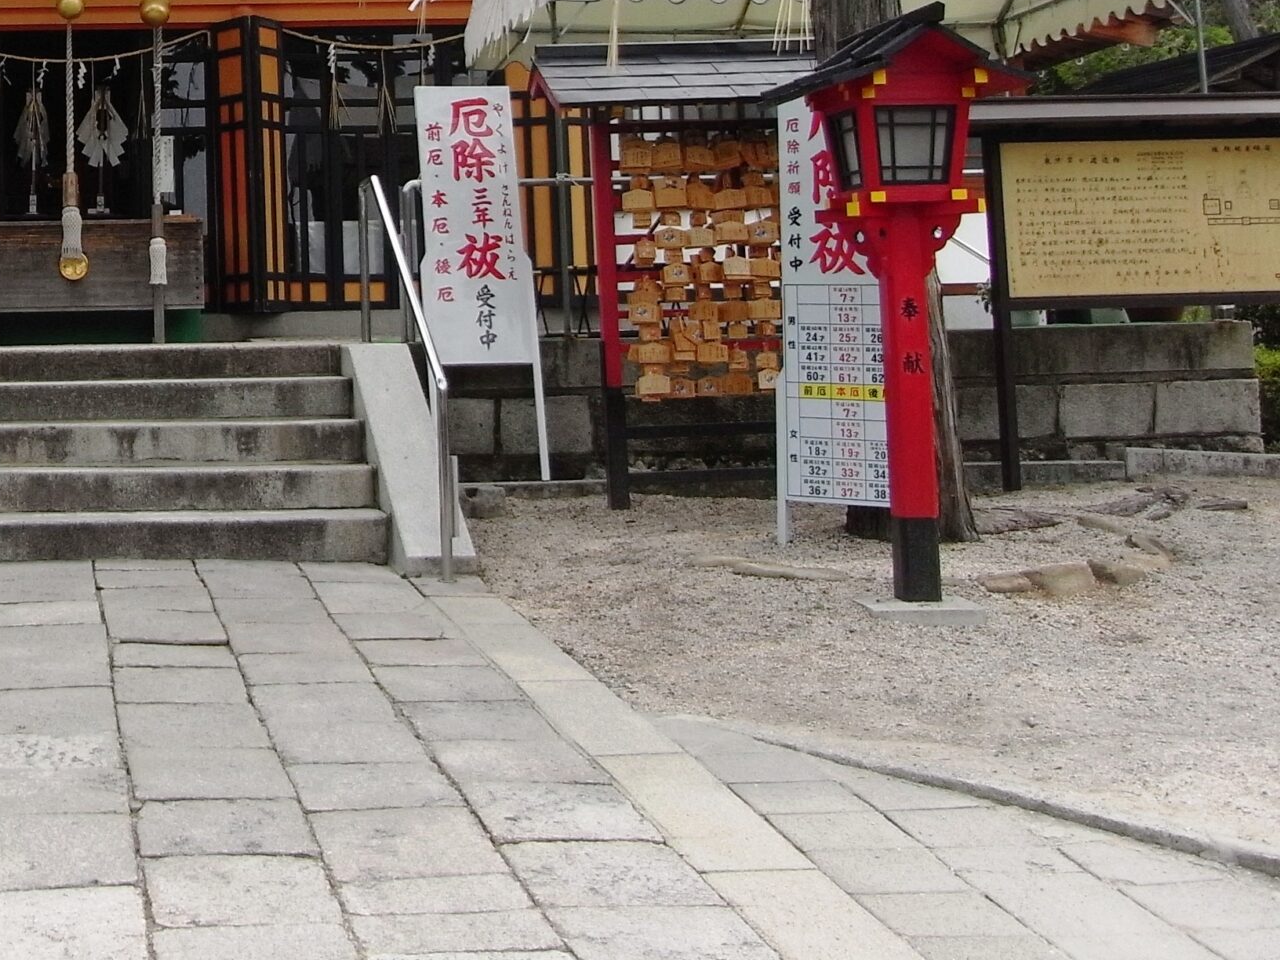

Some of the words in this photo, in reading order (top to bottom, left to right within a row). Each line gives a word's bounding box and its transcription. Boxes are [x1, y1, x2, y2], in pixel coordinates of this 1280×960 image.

[785, 118, 801, 196] 厄除祈願
[787, 206, 804, 273] 受付中
[839, 293, 855, 303] 7才
[476, 284, 497, 351] 受付中
[838, 313, 857, 323] 13才
[788, 316, 796, 350] 男性
[805, 332, 825, 342] 24才
[839, 333, 857, 343] 25才
[901, 297, 925, 374] 奉献
[806, 352, 825, 362] 41才
[839, 353, 858, 363] 42才
[806, 371, 825, 381] 60才
[839, 373, 858, 383] 61才
[804, 386, 827, 396] 前厄
[836, 387, 860, 397] 本厄
[868, 388, 886, 398] 後
[842, 408, 857, 418] 7才
[840, 428, 859, 438] 13才
[789, 429, 798, 463] 女性
[808, 446, 827, 456] 18才
[840, 448, 860, 458] 19才
[808, 466, 827, 476] 32才
[841, 468, 860, 478] 33才
[808, 485, 827, 496] 36才
[841, 487, 860, 498] 37才
